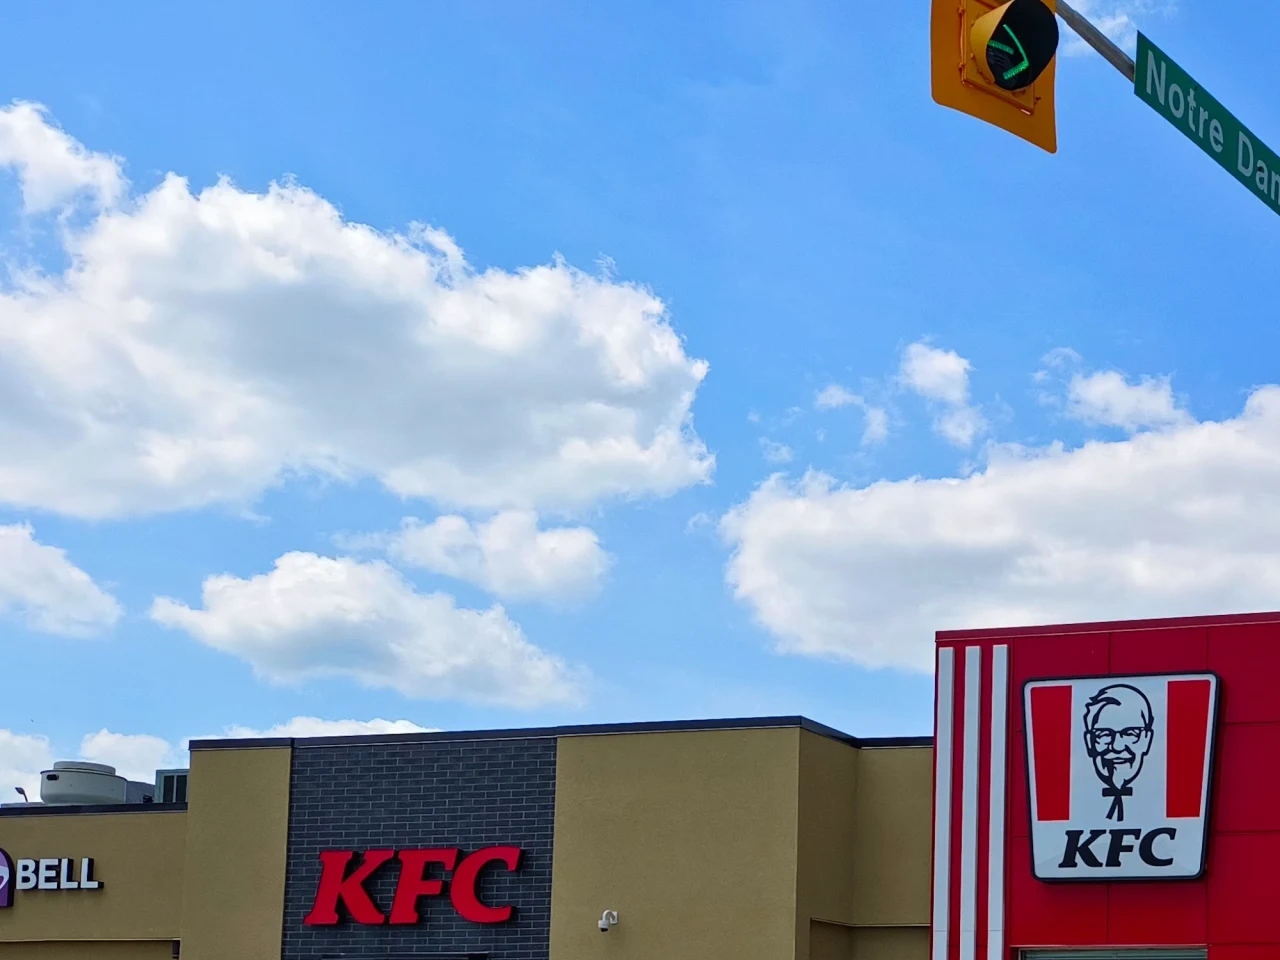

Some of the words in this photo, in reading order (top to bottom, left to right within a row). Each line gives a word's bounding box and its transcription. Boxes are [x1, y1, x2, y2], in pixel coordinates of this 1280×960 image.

[1146, 50, 1224, 153] Notre
[15, 857, 101, 891] BELL
[1057, 827, 1178, 869] KFC
[302, 845, 522, 926] KFC
